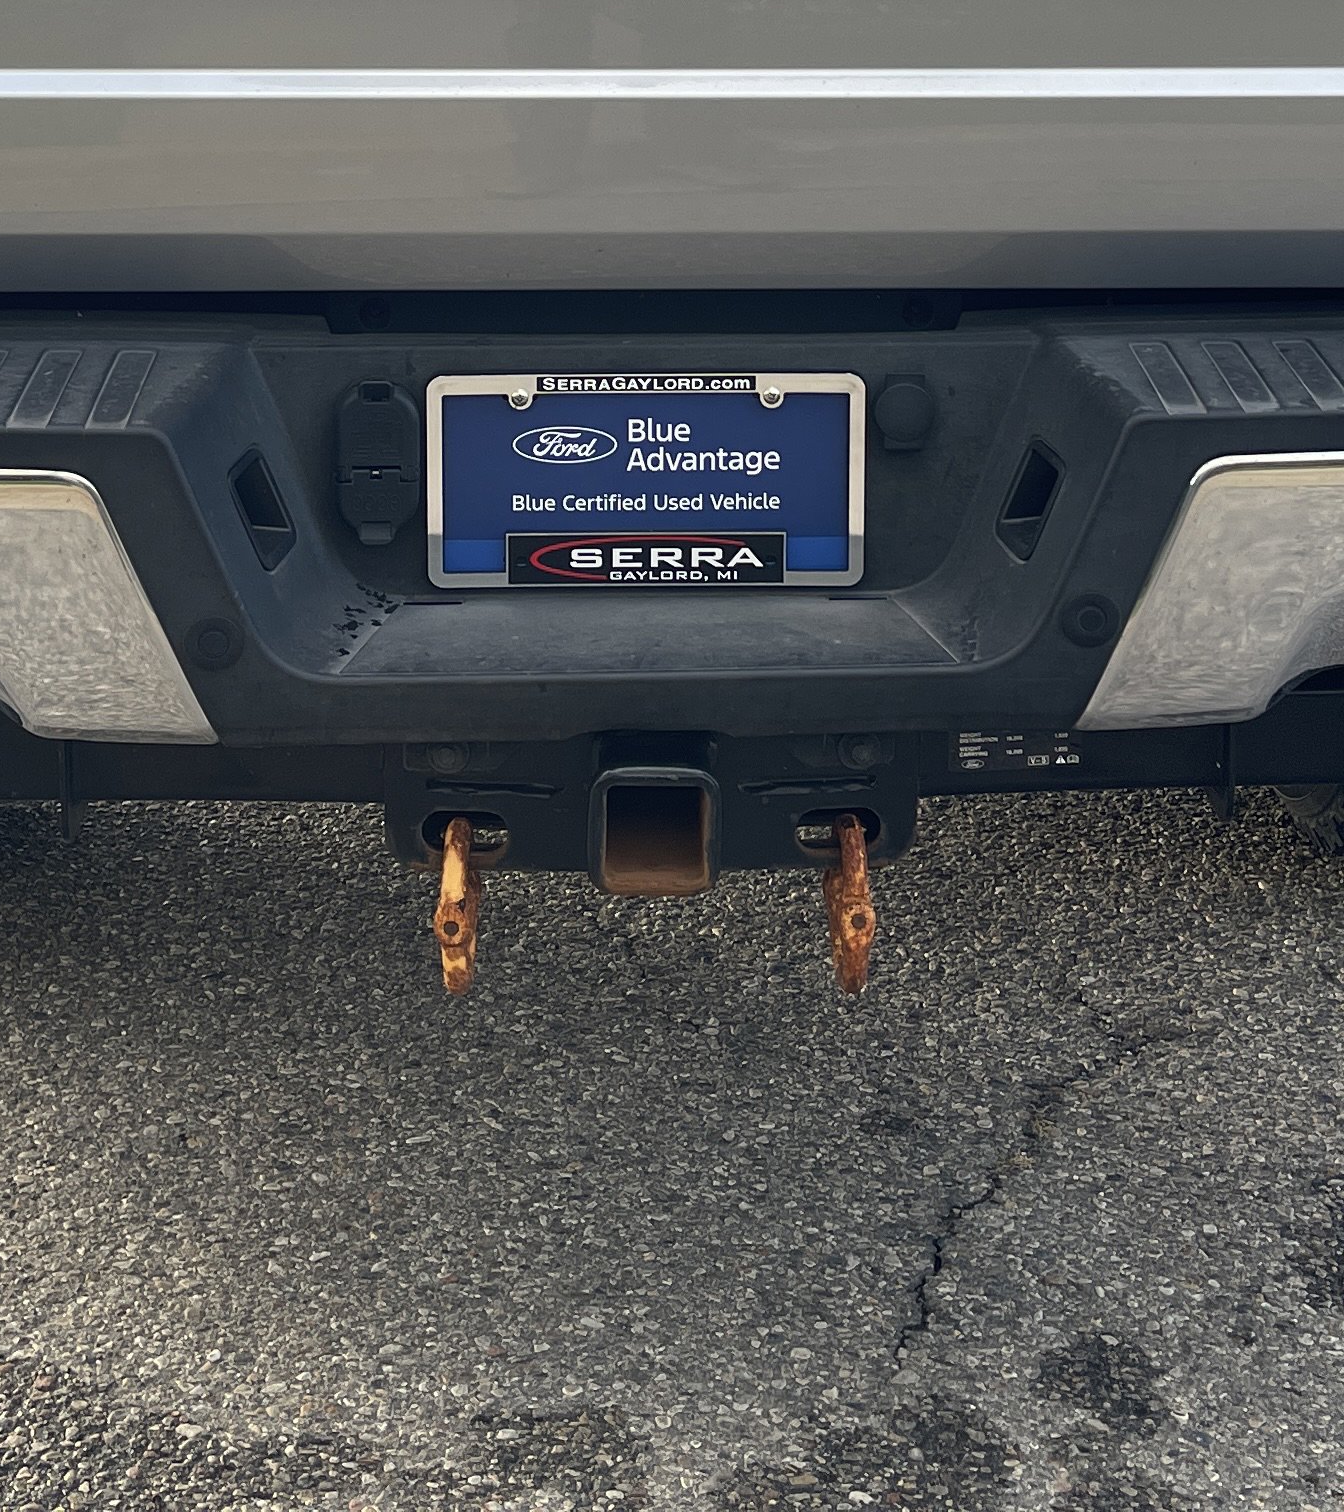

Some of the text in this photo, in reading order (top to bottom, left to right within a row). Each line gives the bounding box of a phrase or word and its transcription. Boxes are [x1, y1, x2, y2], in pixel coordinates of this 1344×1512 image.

[627, 418, 690, 442] Blue
[533, 430, 596, 458] Ford
[626, 447, 781, 475] Advantage
[512, 492, 781, 511] Blue Certified Used Vehicle
[569, 547, 763, 568] SERRA
[609, 570, 738, 581] GAYLORD, MI
